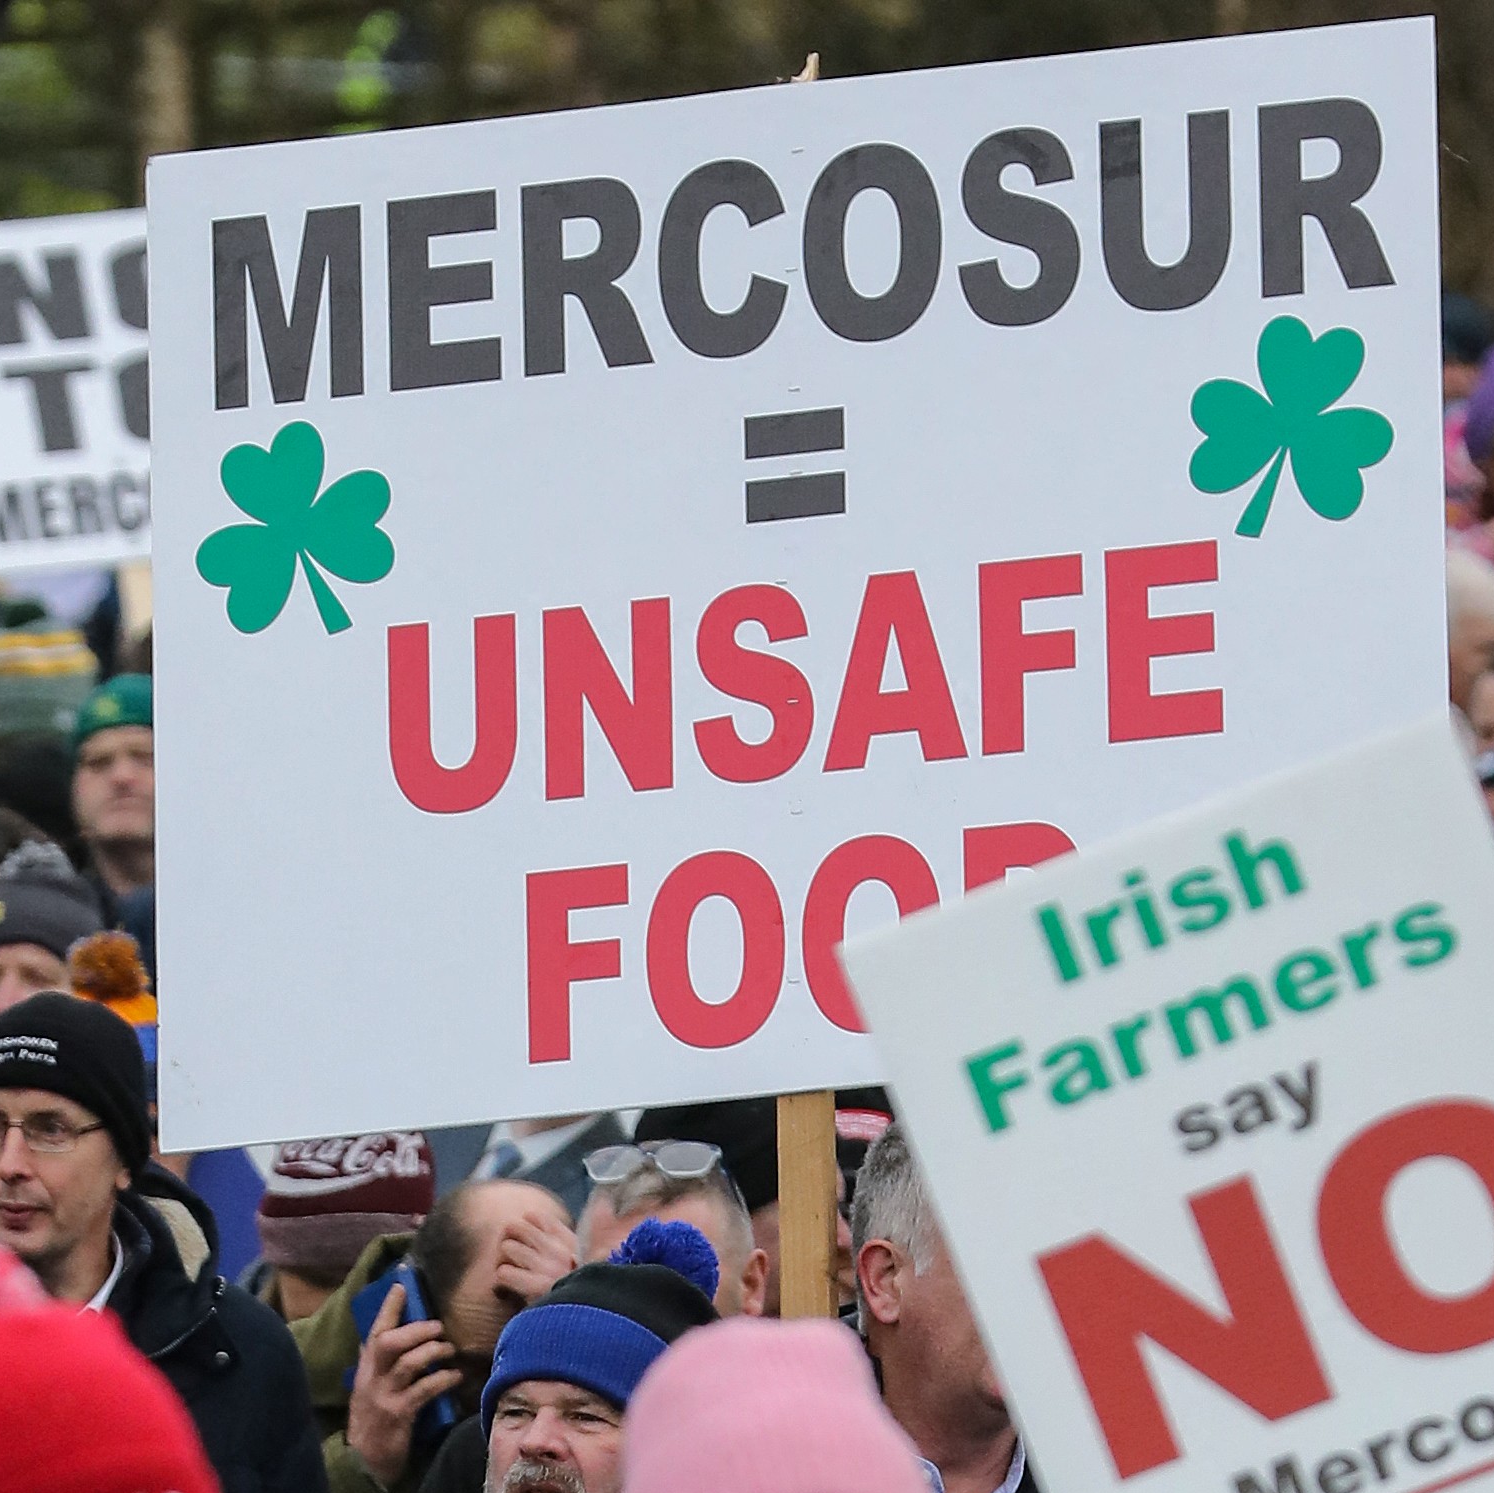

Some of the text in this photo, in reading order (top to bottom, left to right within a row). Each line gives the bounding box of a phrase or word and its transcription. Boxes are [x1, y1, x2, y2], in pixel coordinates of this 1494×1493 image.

[211, 97, 1396, 411] MERCOSUR
[386, 539, 1225, 815] UNSAFE
[964, 903, 1458, 1135] Farmers
[1036, 832, 1306, 984] Irish
[1175, 1063, 1319, 1153] say
